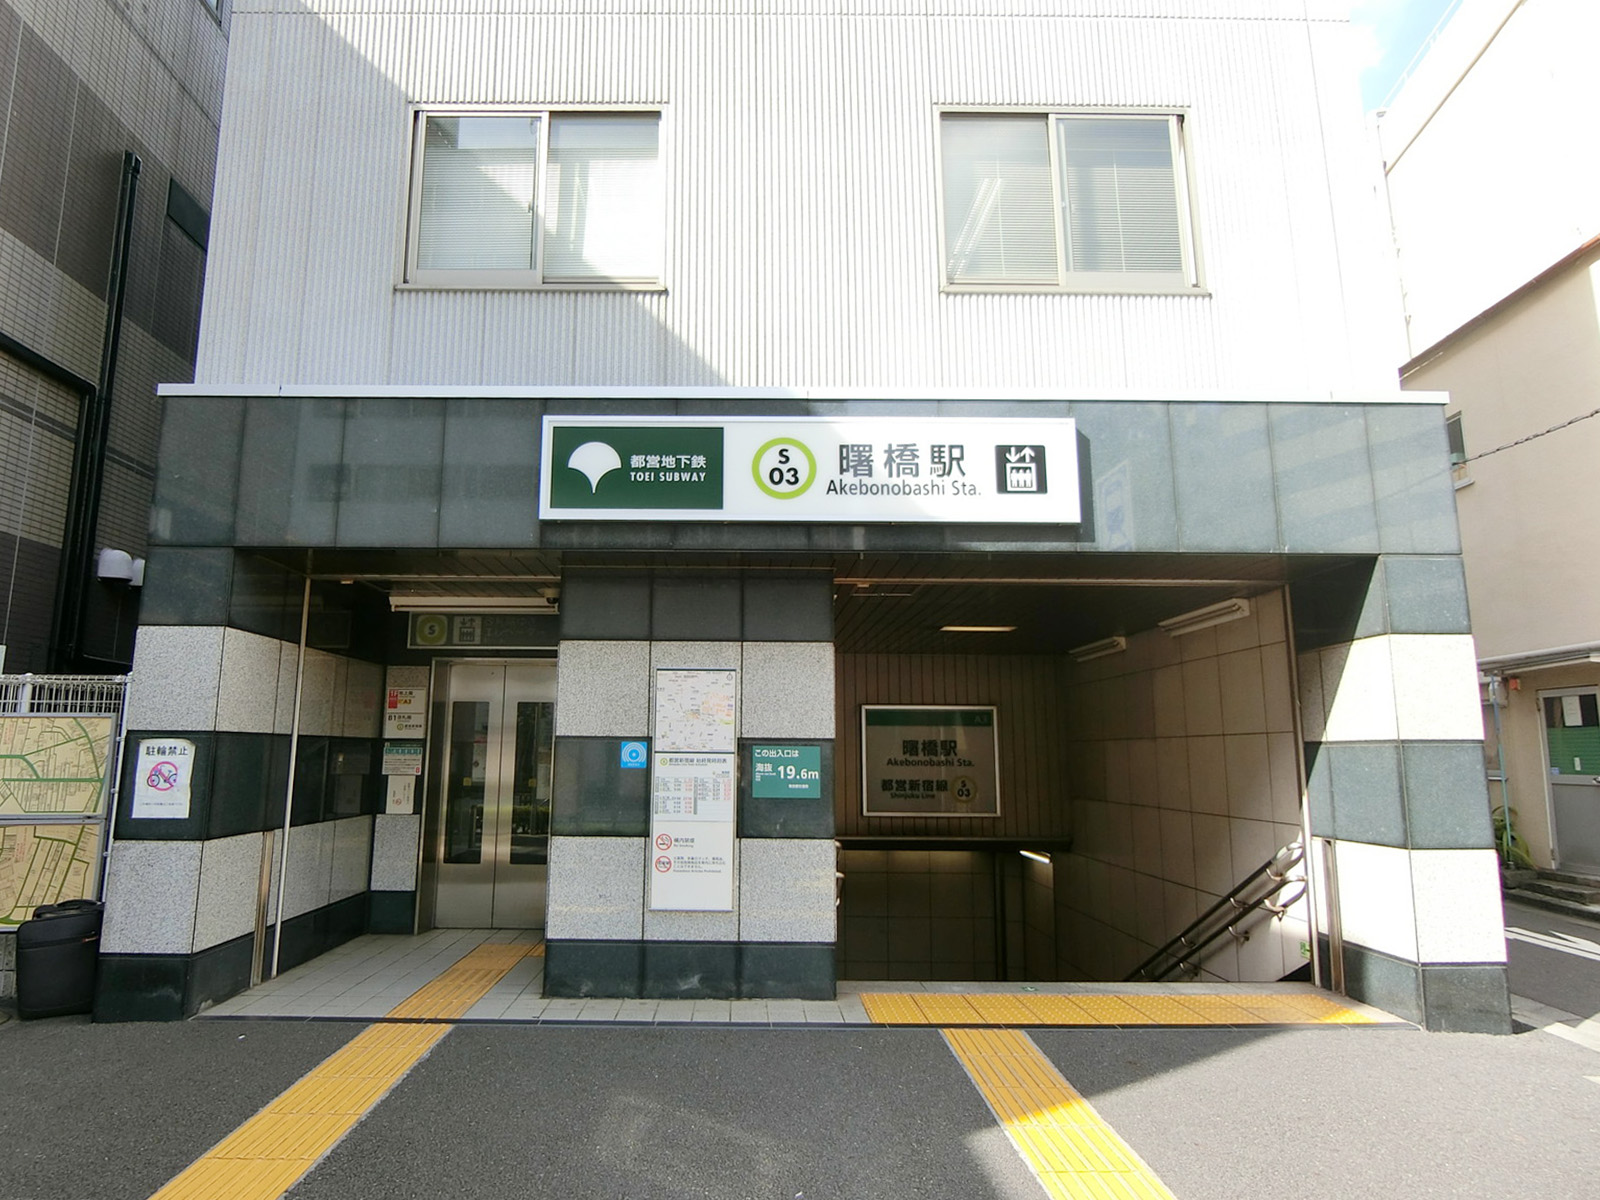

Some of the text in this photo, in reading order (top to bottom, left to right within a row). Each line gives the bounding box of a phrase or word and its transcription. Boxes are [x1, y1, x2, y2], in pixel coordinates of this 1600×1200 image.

[630, 454, 707, 469] 都営地下鉄
[778, 448, 790, 465] S
[838, 443, 966, 478] 曙橋駅
[630, 472, 706, 482] TOEI SUBWAY
[769, 467, 799, 486] 03
[826, 479, 982, 496] Akebonobashi Sta.
[754, 749, 800, 758] この出入口は
[902, 739, 957, 756] 曙橋駅
[886, 758, 975, 767] Akebonobashi Sta.
[777, 765, 819, 780] 19.6m
[957, 788, 971, 798] 03
